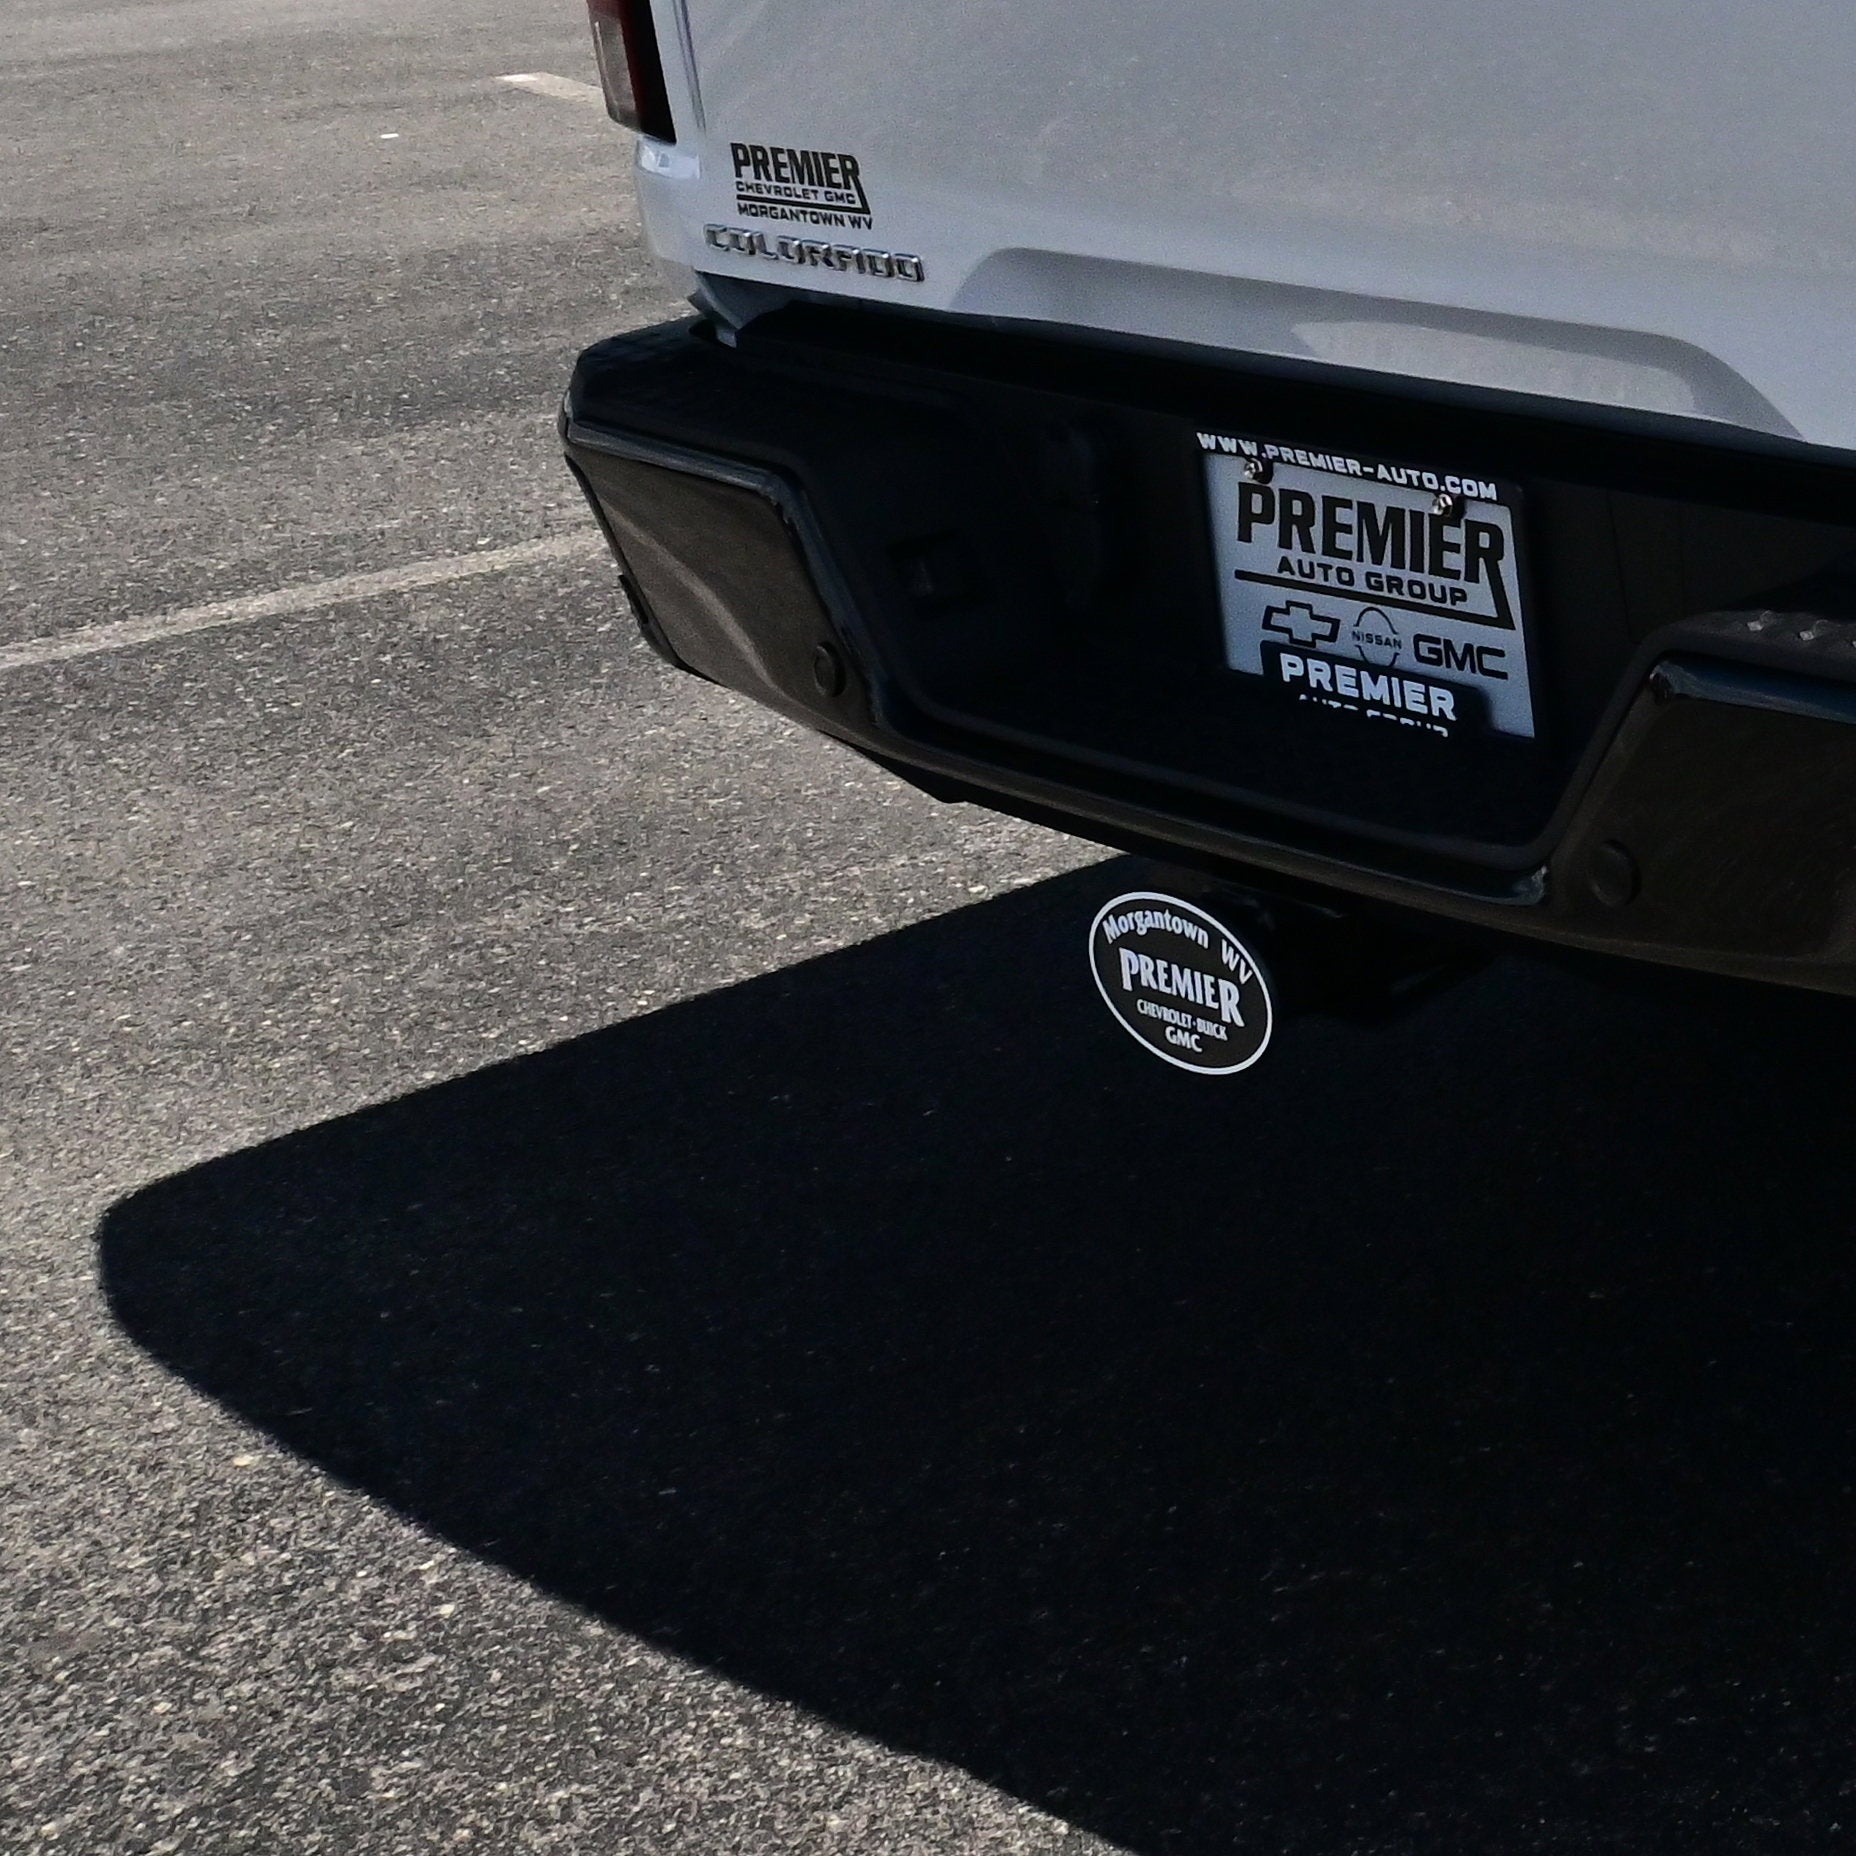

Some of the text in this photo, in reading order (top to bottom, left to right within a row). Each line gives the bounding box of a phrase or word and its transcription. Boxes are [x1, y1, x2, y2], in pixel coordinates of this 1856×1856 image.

[730, 143, 870, 214] PREMIER
[736, 181, 857, 204] CHEVROLET GMC
[737, 203, 873, 230] MORGANTOWN WV
[703, 224, 925, 282] COLORADO
[1196, 431, 1498, 501] WWW.PREMIER-AUTO.COM
[1237, 481, 1516, 631] PREMIER
[1277, 556, 1468, 606] AUTO GROUP
[1351, 629, 1402, 650] NISSAN
[1413, 633, 1509, 680] GMC
[1279, 652, 1457, 722] PREMIER
[1102, 908, 1253, 985] Morgantown WV
[1118, 947, 1245, 1027] PREMIER
[1165, 1026, 1203, 1053] GMC
